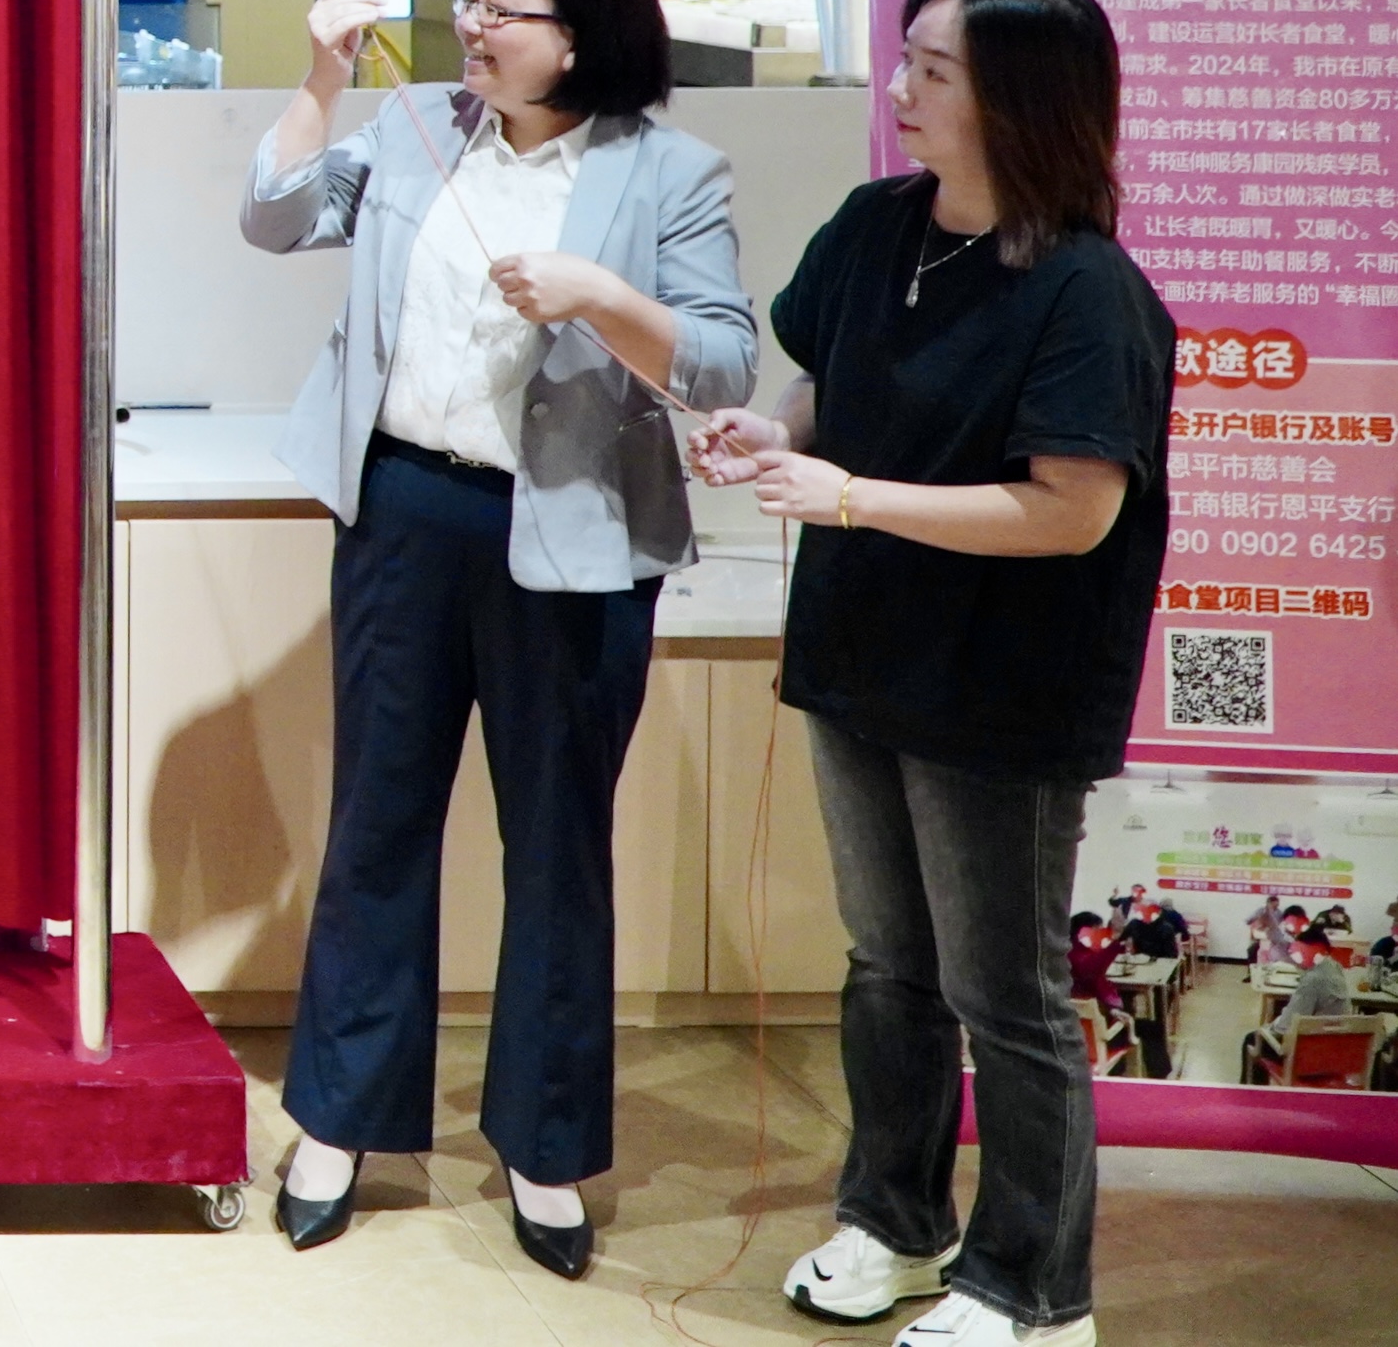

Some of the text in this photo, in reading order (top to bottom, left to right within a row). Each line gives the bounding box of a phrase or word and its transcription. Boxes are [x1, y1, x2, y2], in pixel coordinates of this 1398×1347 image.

[1120, 55, 1398, 78] 需求。2024年，我市在原有
[1168, 410, 1394, 443] 会开户银行及账号
[1167, 452, 1337, 483] 恩平市慈善会
[1169, 491, 1396, 523] 工商银行恩平支行
[1168, 528, 1386, 560] 90 0902 6425
